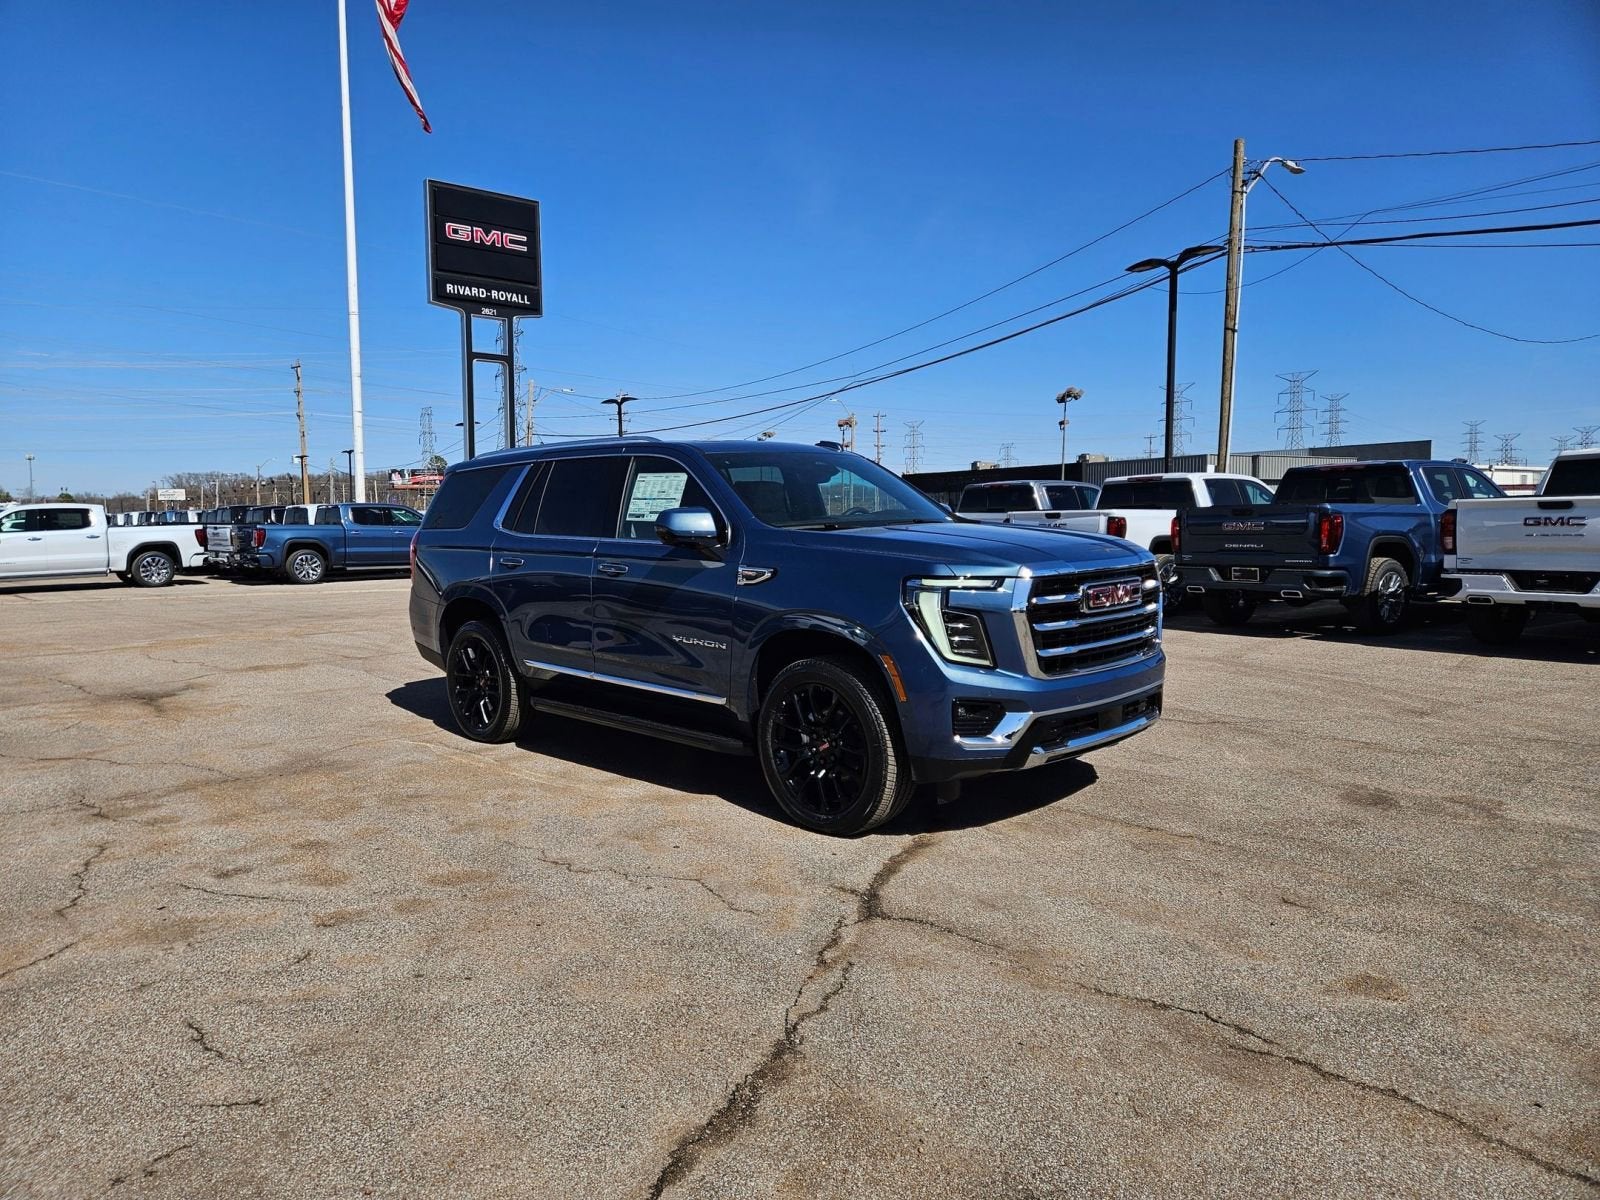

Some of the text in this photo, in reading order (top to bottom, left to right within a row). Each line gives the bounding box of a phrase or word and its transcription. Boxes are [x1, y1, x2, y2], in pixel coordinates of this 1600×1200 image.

[445, 222, 528, 252] GMC
[446, 283, 531, 305] RIVARD-ROYALL
[1222, 521, 1265, 531] GMC
[1523, 516, 1588, 527] GMC
[1088, 582, 1142, 608] GMC
[672, 634, 727, 650] YUKON
